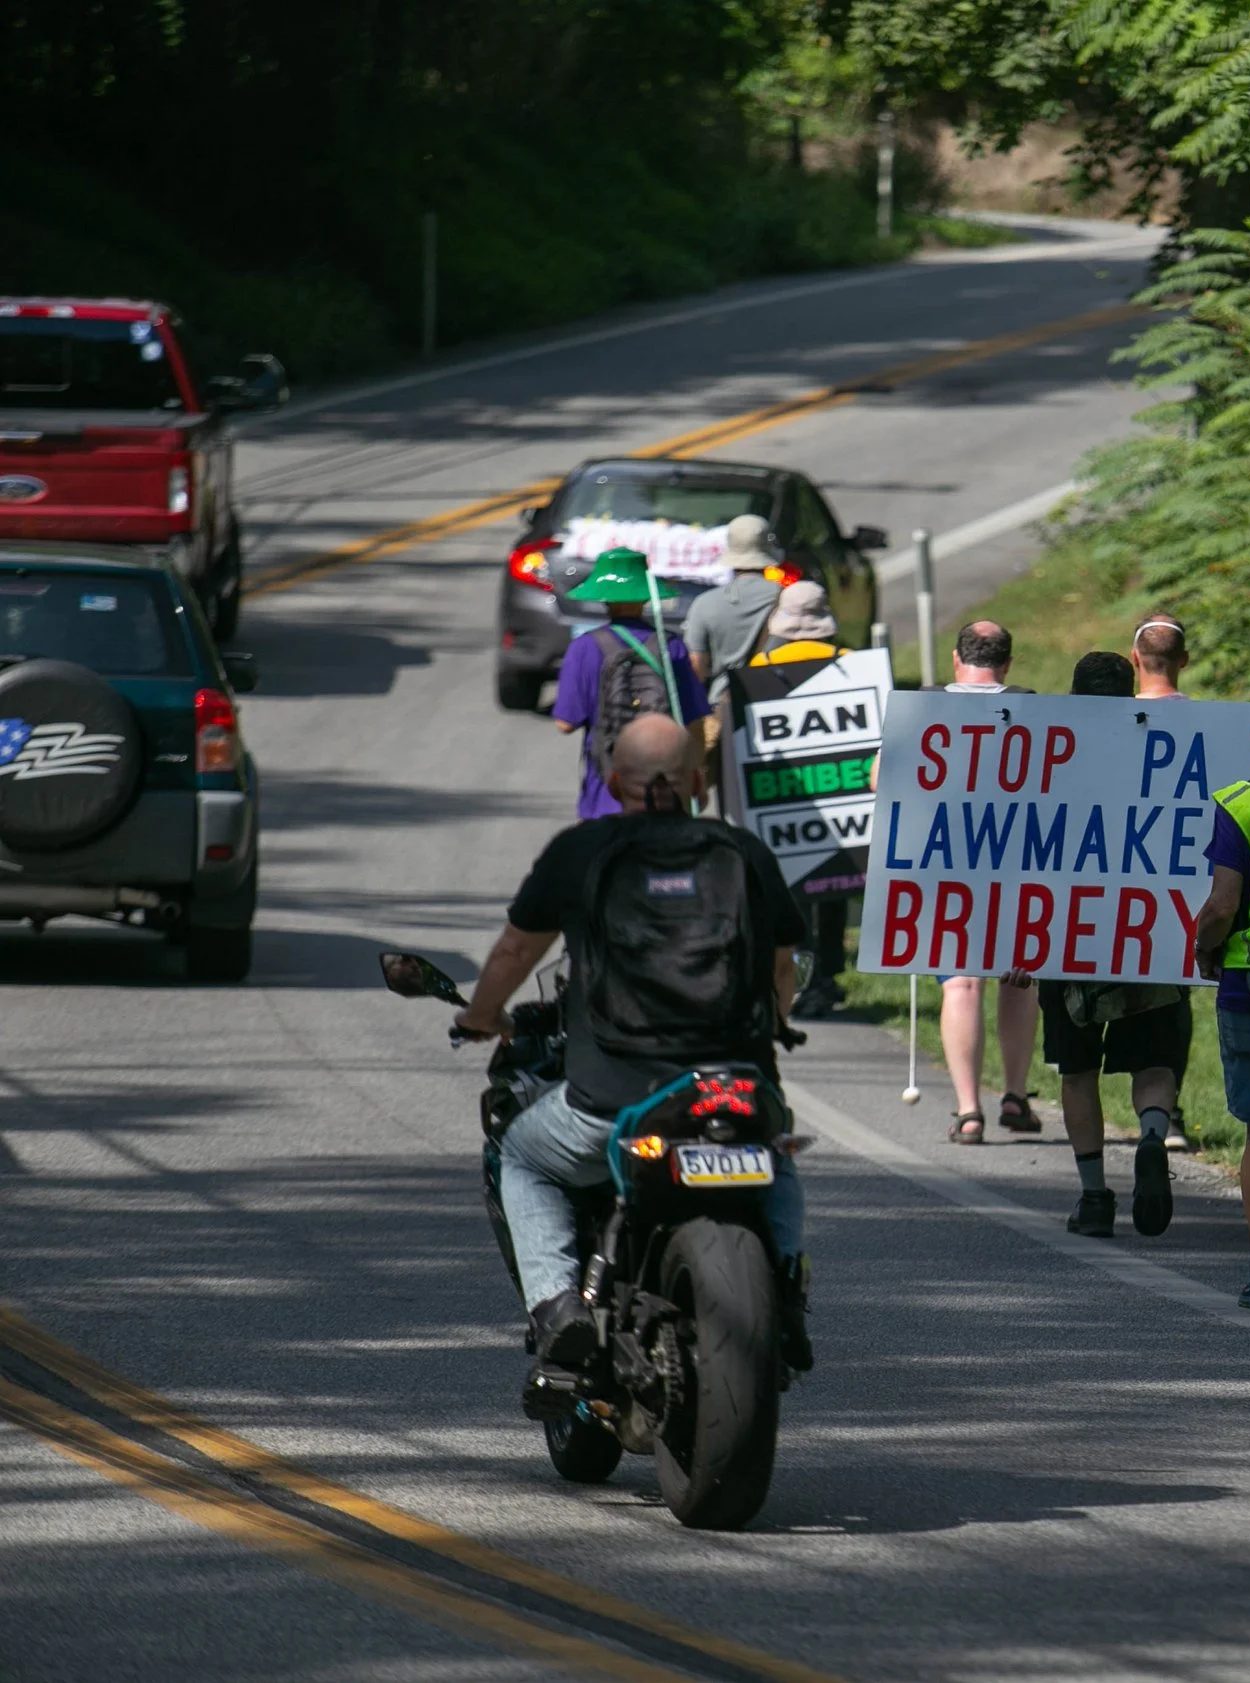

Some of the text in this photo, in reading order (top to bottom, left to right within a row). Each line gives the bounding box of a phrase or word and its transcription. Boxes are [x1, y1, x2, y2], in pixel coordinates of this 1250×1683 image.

[761, 703, 868, 742] BAN
[917, 723, 1209, 801] STOP PA
[769, 814, 870, 847] NOW
[886, 801, 1215, 877] LAWMAKE
[880, 879, 1201, 979] BRIBERY
